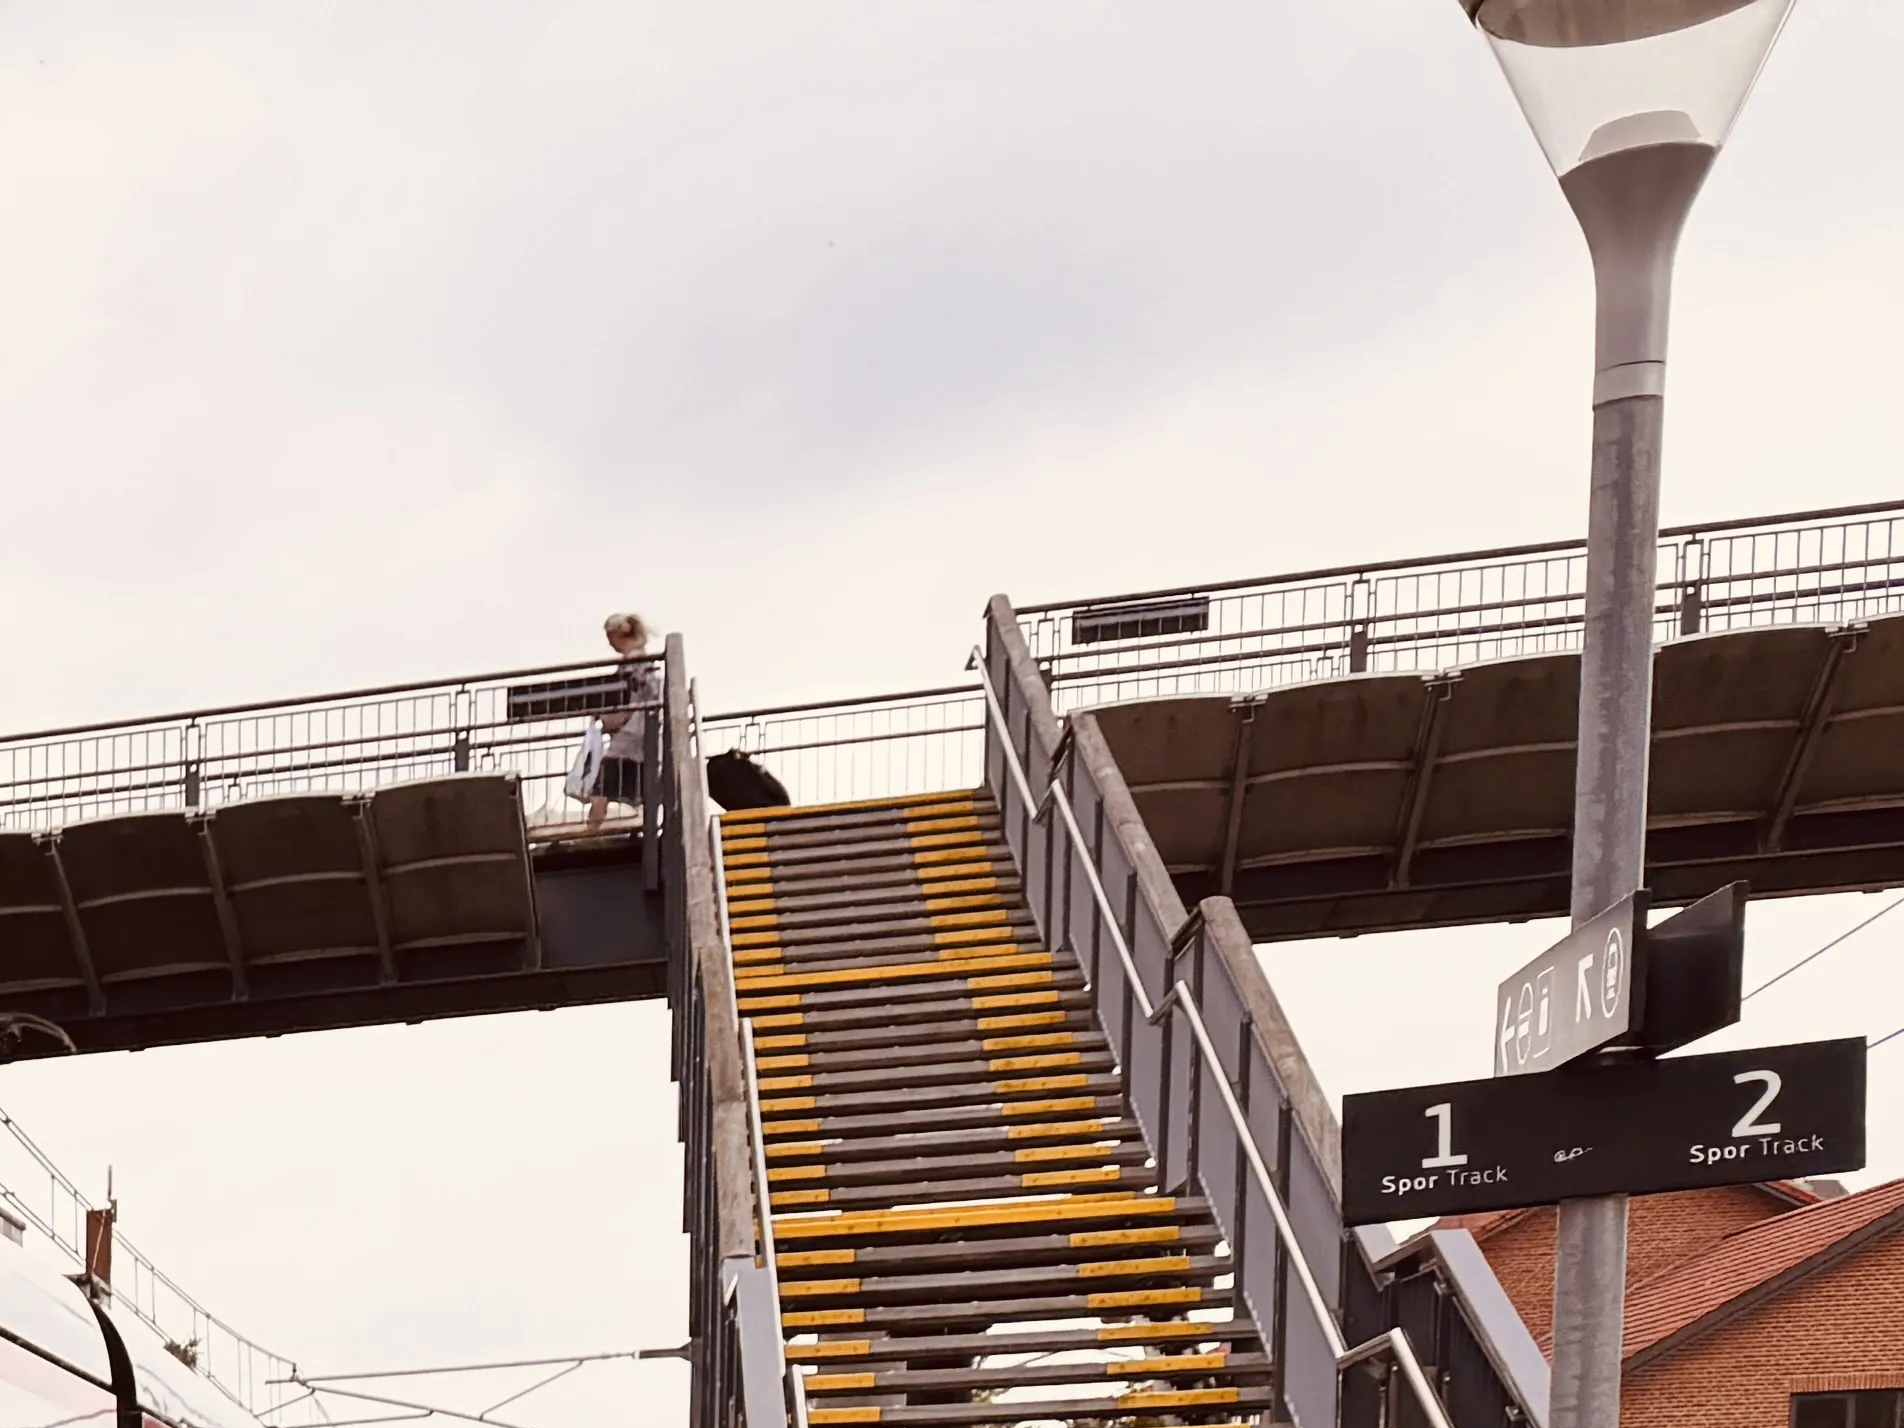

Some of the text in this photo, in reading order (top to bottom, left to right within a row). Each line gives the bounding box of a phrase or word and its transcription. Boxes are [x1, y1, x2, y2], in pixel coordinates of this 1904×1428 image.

[1731, 1069, 1782, 1138] 2
[1421, 1102, 1468, 1169] 1
[1689, 1134, 1825, 1165] Spor Track
[1380, 1165, 1509, 1196] Spor Track
